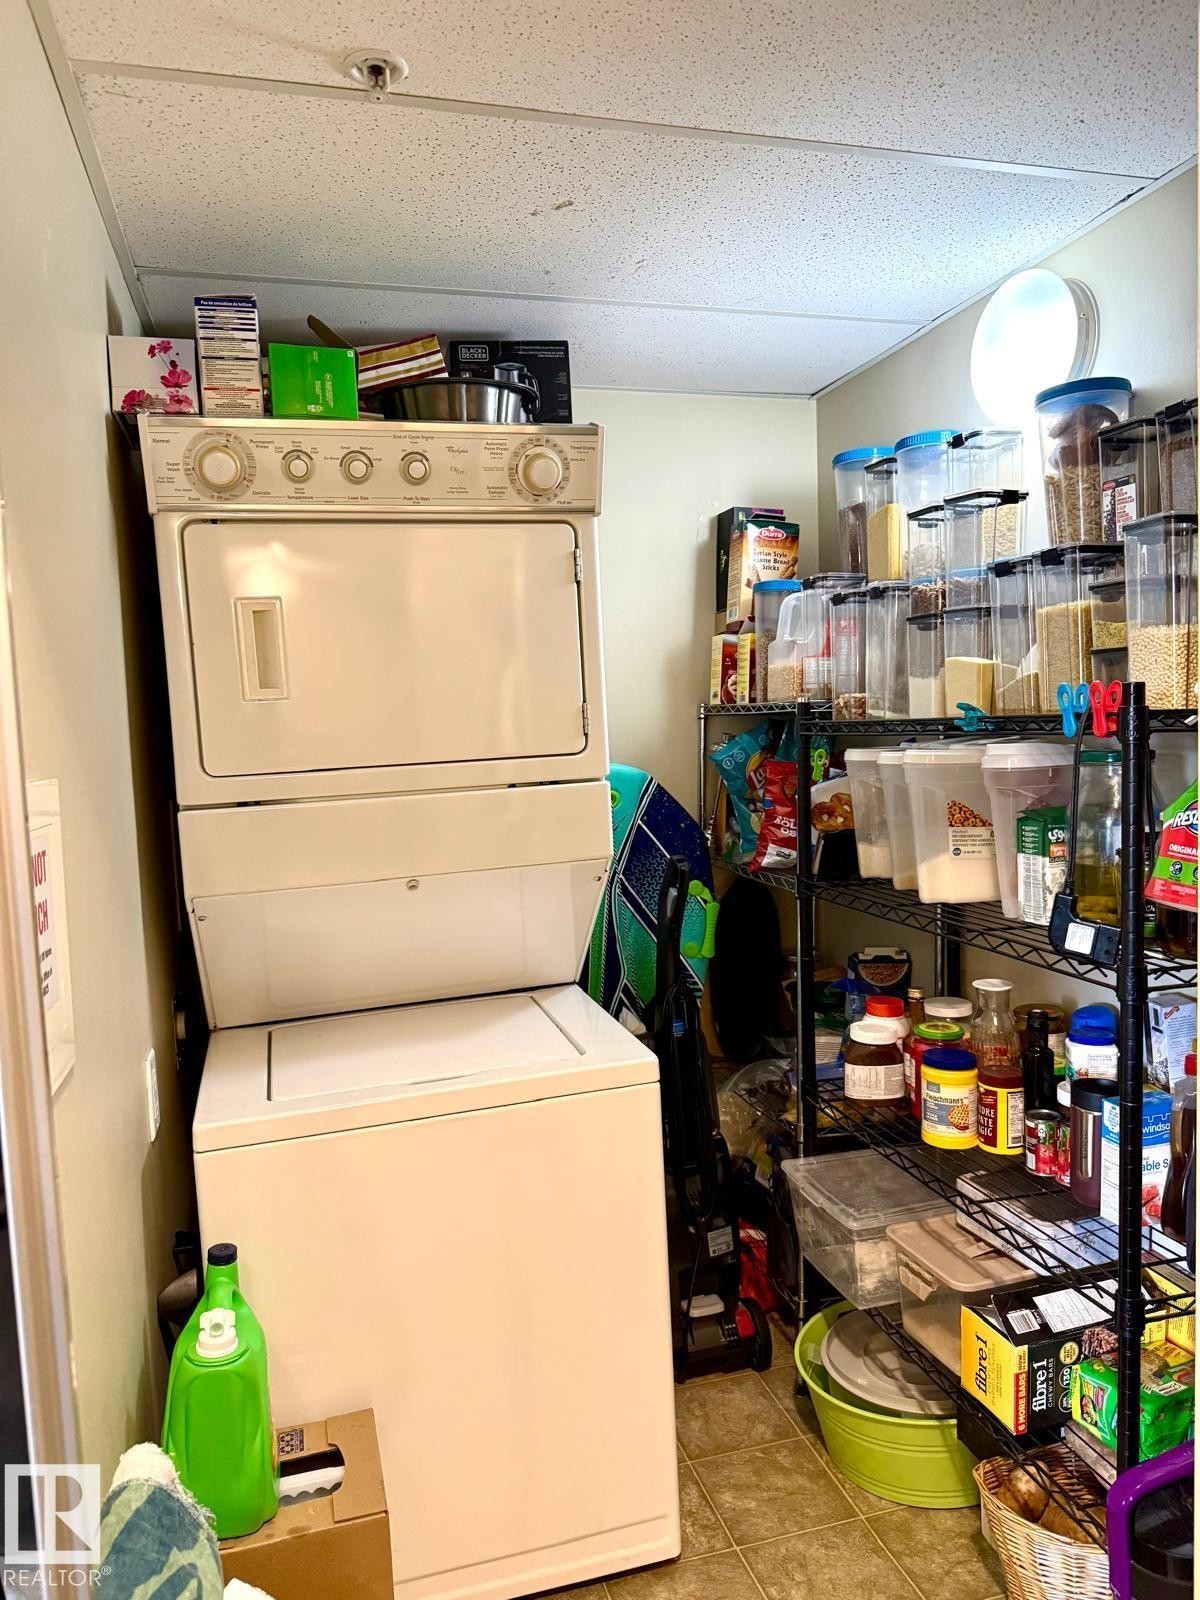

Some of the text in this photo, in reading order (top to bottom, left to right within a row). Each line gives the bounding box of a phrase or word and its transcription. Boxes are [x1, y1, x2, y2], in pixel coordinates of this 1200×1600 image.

[761, 530, 783, 538] Durra
[1168, 843, 1198, 856] ORIGINA
[926, 1092, 964, 1105] Fleischmann's
[1142, 1121, 1171, 1134] windso
[1141, 1159, 1161, 1172] able
[974, 1334, 988, 1396] fibre 1
[1018, 1373, 1027, 1397] BARS
[1031, 1358, 1047, 1412] fibre 1
[1018, 1398, 1026, 1423] MORE
